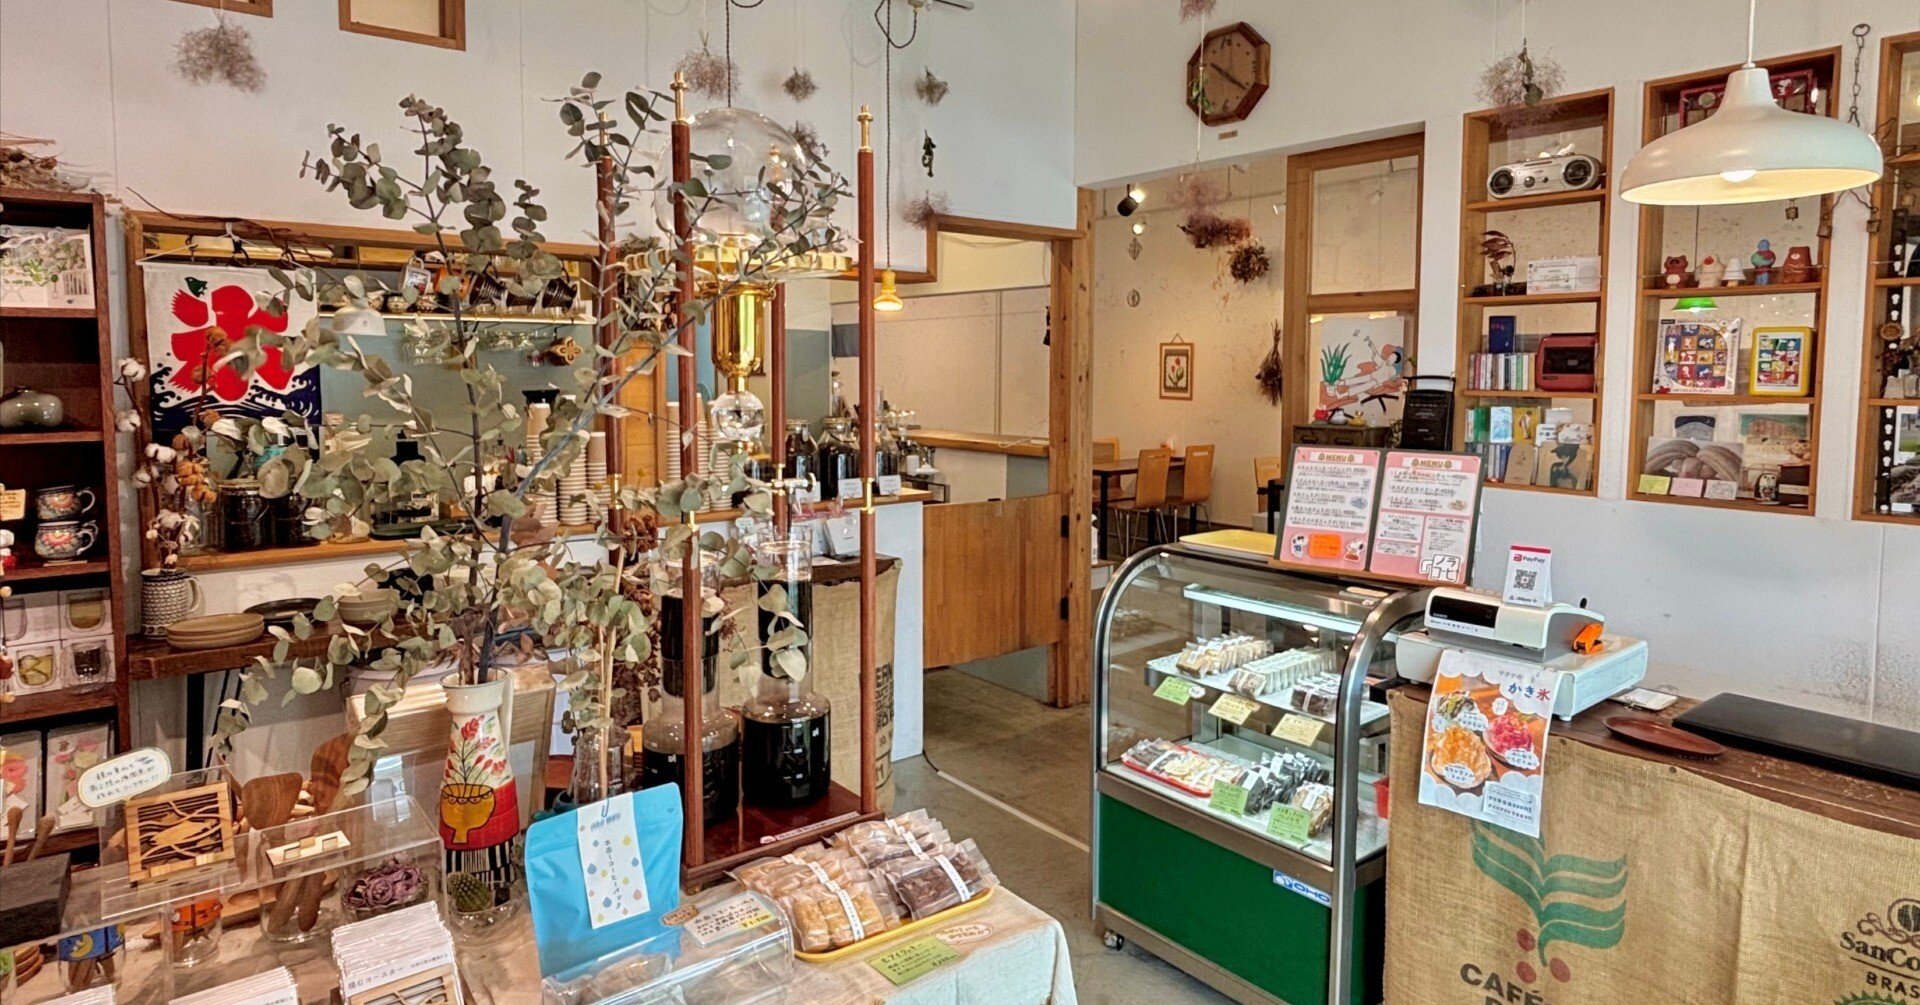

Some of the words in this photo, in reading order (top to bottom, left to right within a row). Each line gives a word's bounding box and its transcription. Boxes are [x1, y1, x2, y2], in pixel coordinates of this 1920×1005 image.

[1325, 454, 1347, 462] MENU
[1420, 460, 1444, 469] MENU
[1436, 557, 1456, 567] ノラ
[1523, 555, 1545, 564] PayPay
[1508, 683, 1550, 701] かき氷
[1866, 971, 1919, 999] BRAS
